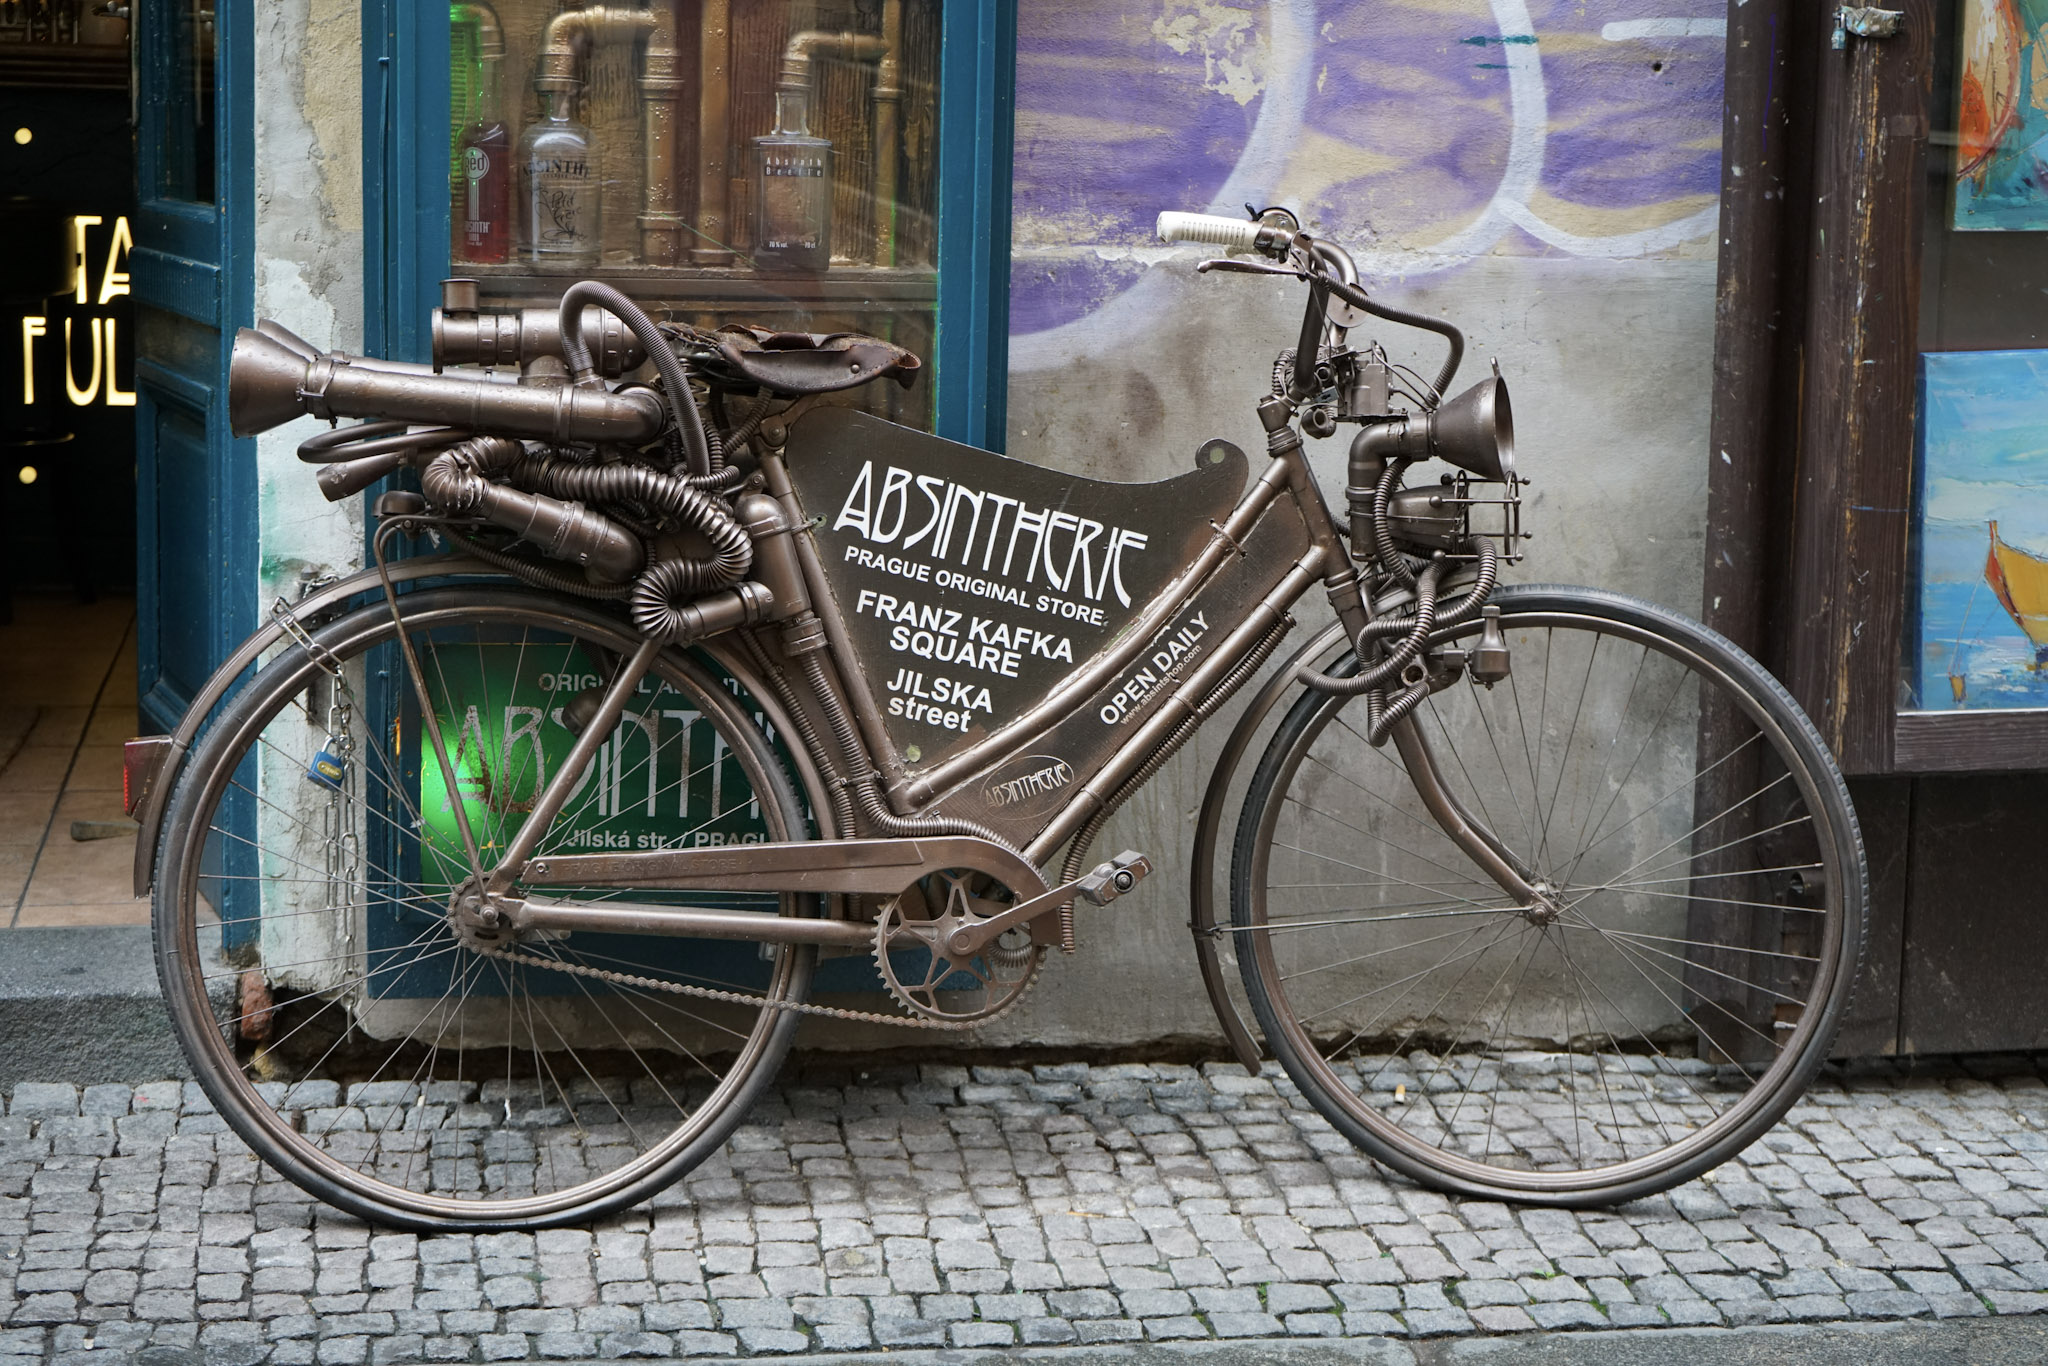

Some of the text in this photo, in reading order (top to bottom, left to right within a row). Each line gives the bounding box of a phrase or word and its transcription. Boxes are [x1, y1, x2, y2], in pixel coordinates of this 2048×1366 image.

[766, 157, 822, 167] Absinth
[832, 460, 1149, 609] ABSINTHERIE
[844, 545, 1105, 627] PRAGUE ORIGINAL STORE
[856, 589, 1074, 664] FRANZ KAFKA
[889, 625, 1022, 678] SQUARE
[1100, 610, 1209, 725] OPEN DAILY
[538, 673, 652, 694] ORIGL
[886, 668, 993, 714] JILSKA
[1120, 644, 1202, 726] www.absintshop.com
[887, 697, 972, 733] street
[985, 763, 1070, 808] ABSINTHERIE
[566, 829, 630, 849] Jilská
[637, 831, 672, 849] str.
